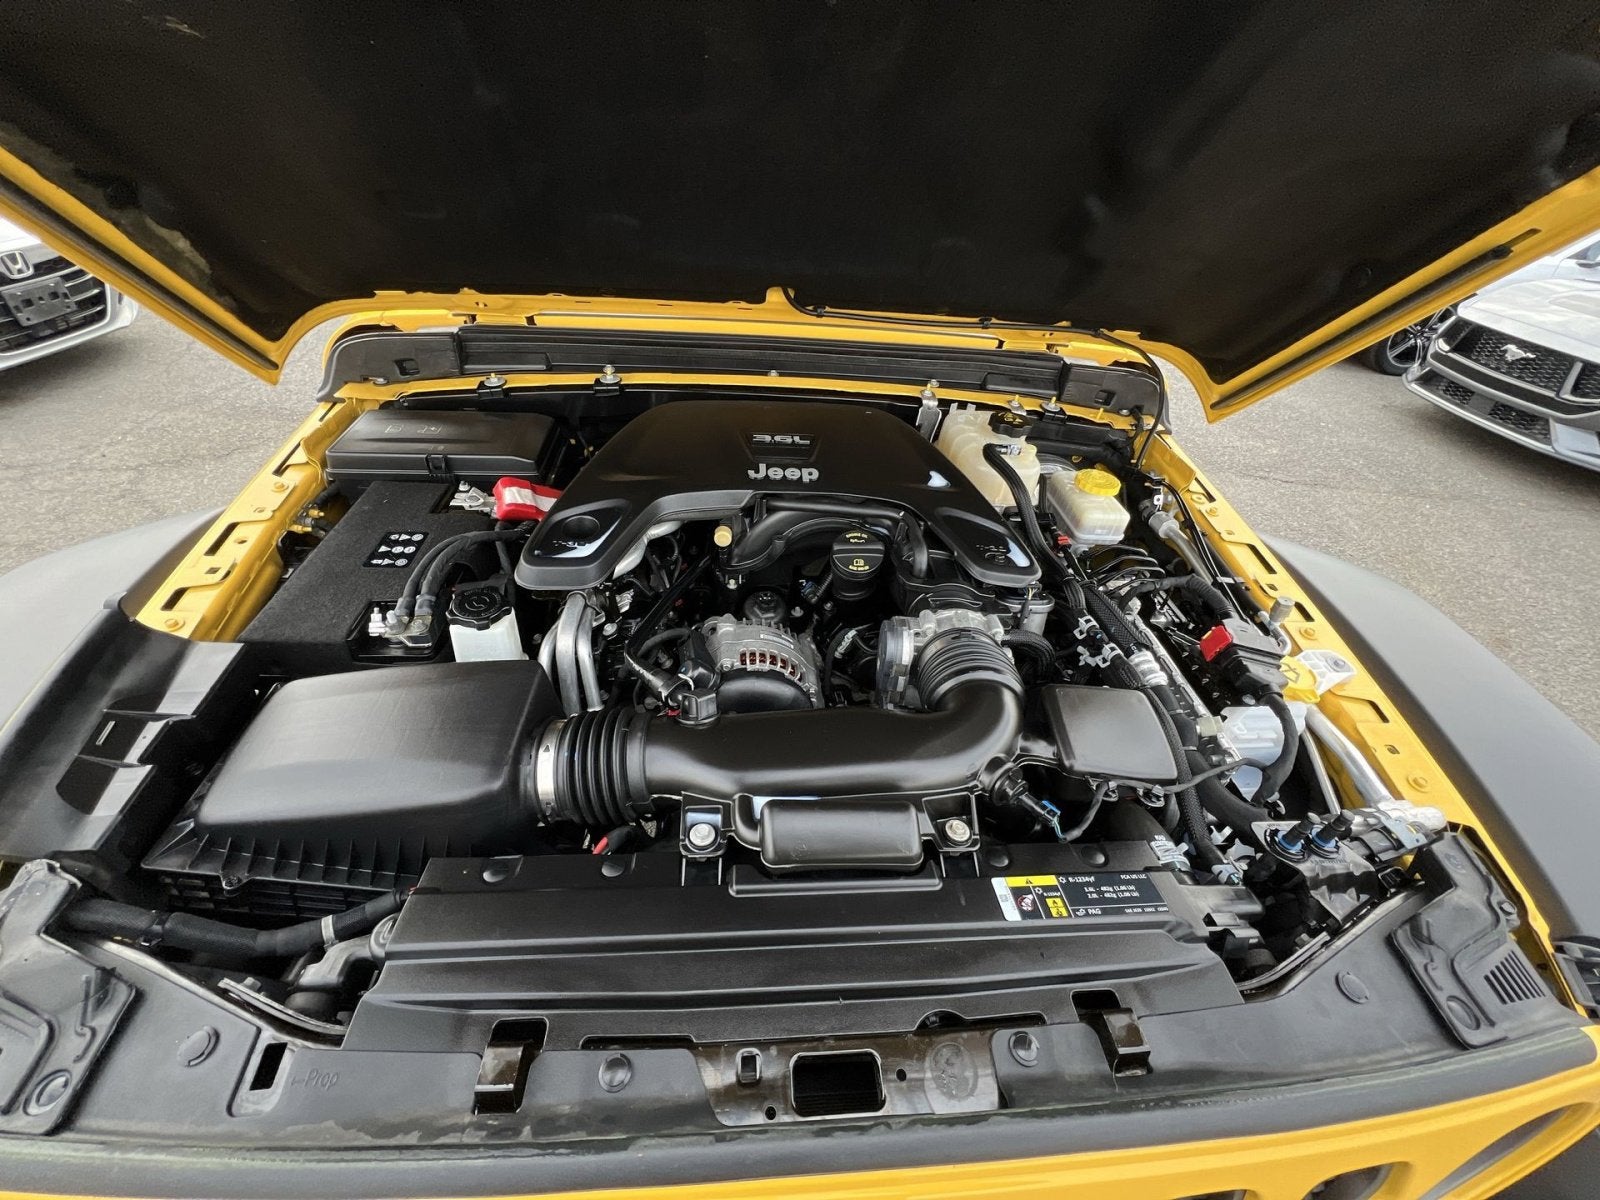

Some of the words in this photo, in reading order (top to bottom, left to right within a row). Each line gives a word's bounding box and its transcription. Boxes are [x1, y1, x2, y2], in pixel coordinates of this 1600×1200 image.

[752, 434, 811, 445] 3.6L
[747, 463, 820, 483] Jeep
[304, 1068, 339, 1091] Prop
